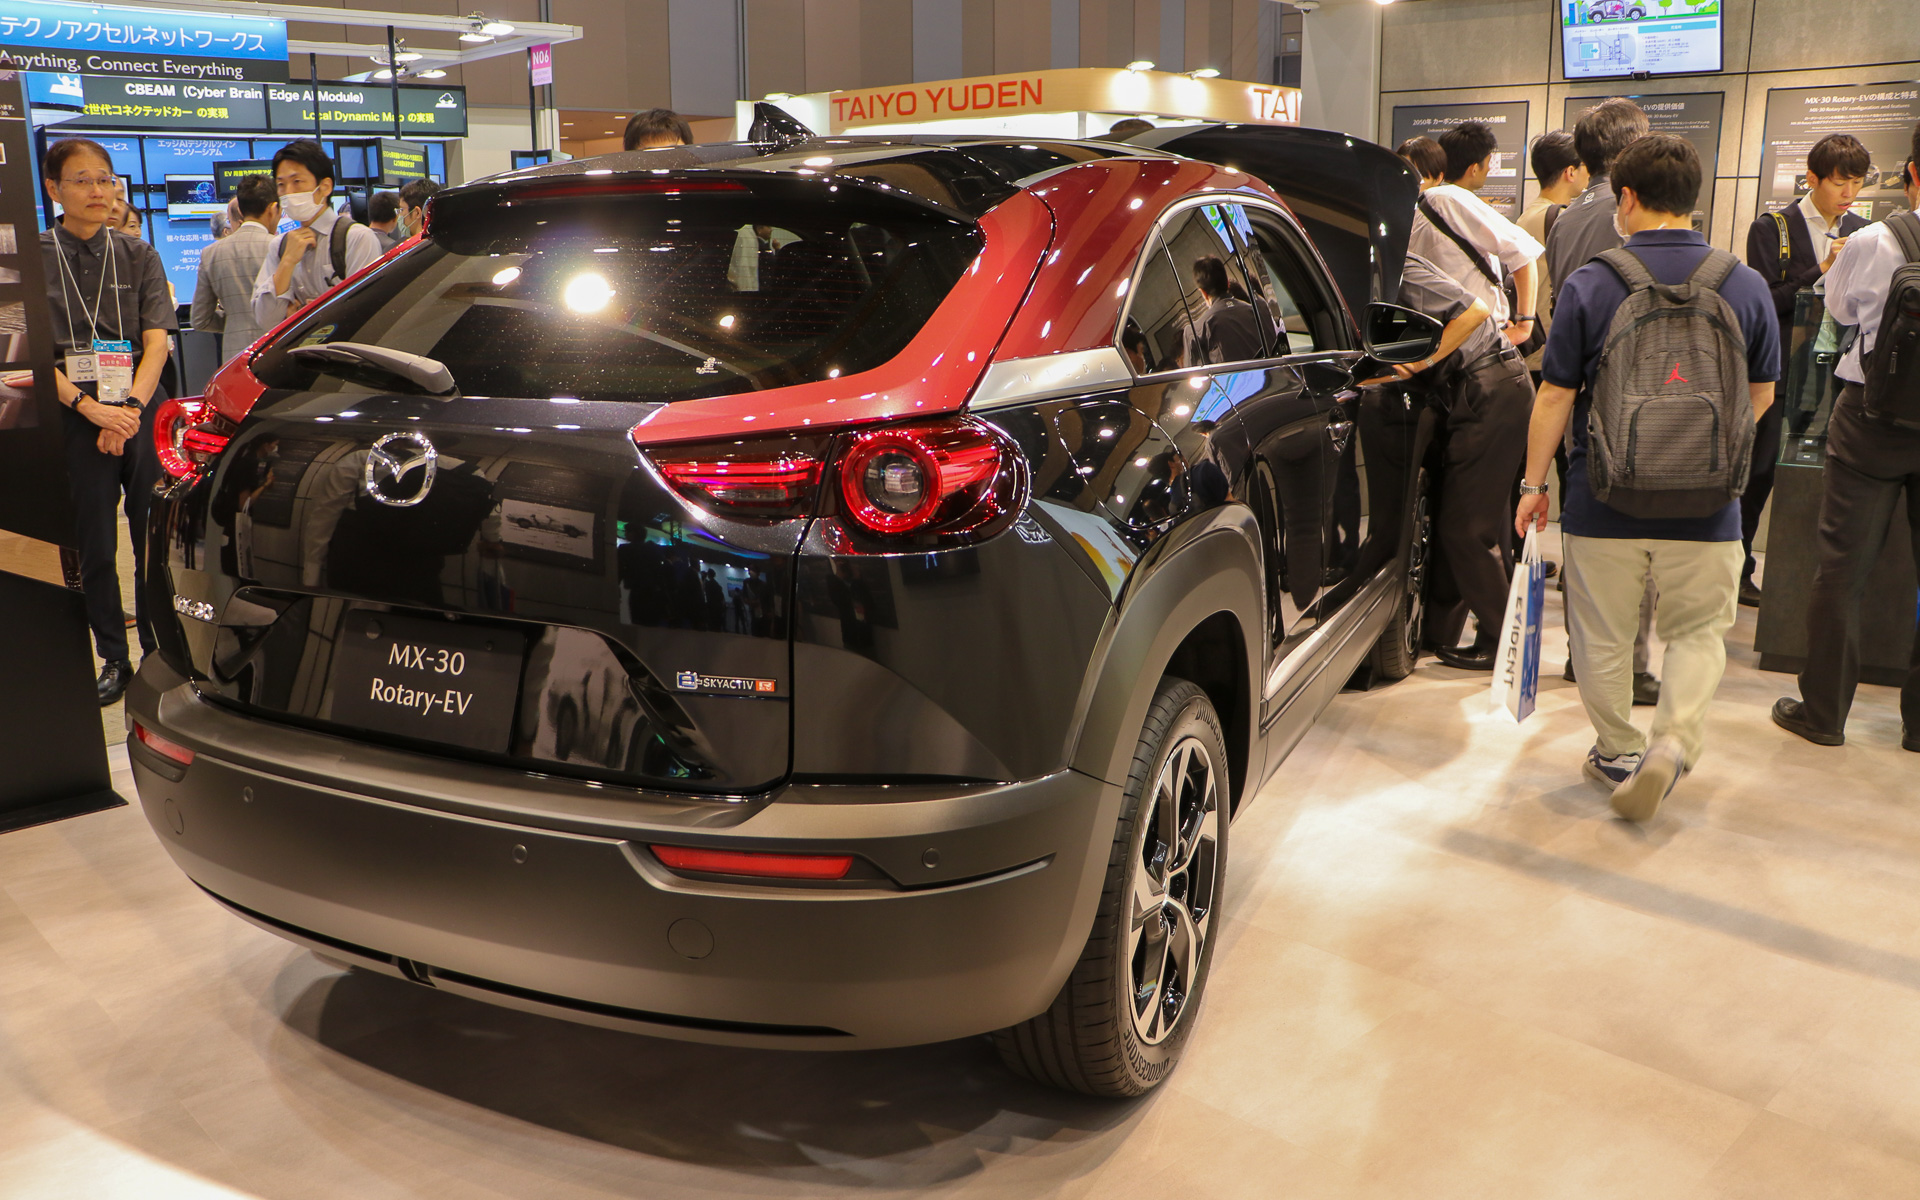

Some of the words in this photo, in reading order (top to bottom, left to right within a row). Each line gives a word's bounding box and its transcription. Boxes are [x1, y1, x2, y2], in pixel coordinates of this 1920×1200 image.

[1, 16, 265, 52] テクノアクセルネットワークス
[0, 50, 82, 73] Anything,
[87, 55, 159, 73] Connect
[163, 59, 244, 80] Everything
[532, 50, 550, 65] N06
[125, 83, 176, 97] CBEAM
[183, 85, 227, 99] (Cyber
[230, 87, 263, 100] Brain
[269, 88, 300, 102] Edge
[317, 90, 364, 104] Module)
[832, 92, 917, 122] TAIYO
[925, 78, 1043, 114] YUDEN
[1253, 87, 1299, 122] TAI
[1804, 95, 1831, 105] MX-30
[197, 107, 230, 119] の実現
[334, 110, 380, 123] Dynamic
[407, 112, 435, 124] の実現
[174, 148, 223, 156] コンソーシアム
[1503, 596, 1523, 690] EVIDENT
[388, 642, 466, 677] MX-30
[370, 677, 474, 716] Rotary-EV
[1123, 1024, 1171, 1082] BRIDGESTONE
